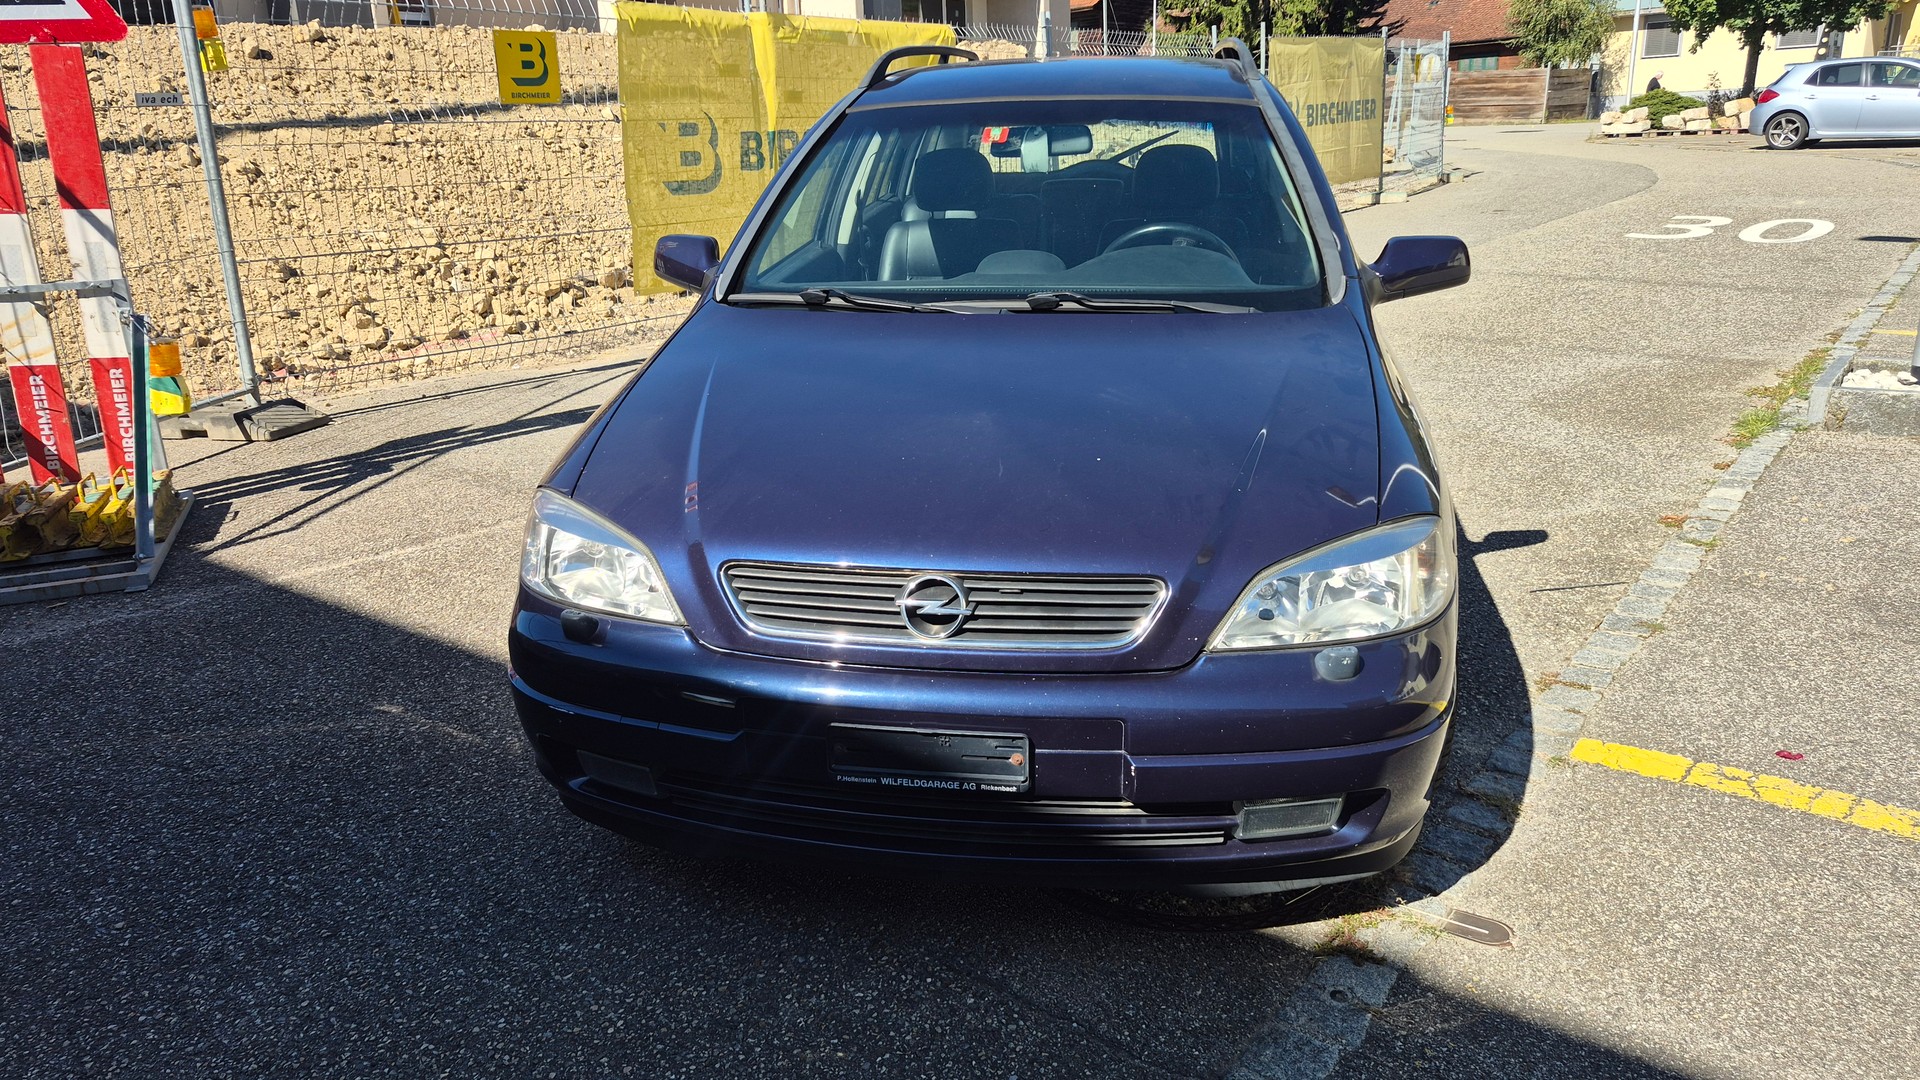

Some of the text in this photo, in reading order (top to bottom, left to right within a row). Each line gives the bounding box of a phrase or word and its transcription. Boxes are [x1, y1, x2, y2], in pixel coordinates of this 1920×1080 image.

[1307, 99, 1376, 127] BIRCHMEIER
[1624, 215, 1835, 244] 30
[29, 373, 61, 471] BIRCHMEIER
[109, 367, 135, 463] BIRCHMEIER
[880, 777, 960, 789] WILFELDGARAGE
[962, 782, 976, 790] AG
[980, 783, 1018, 792] Rickenbach
